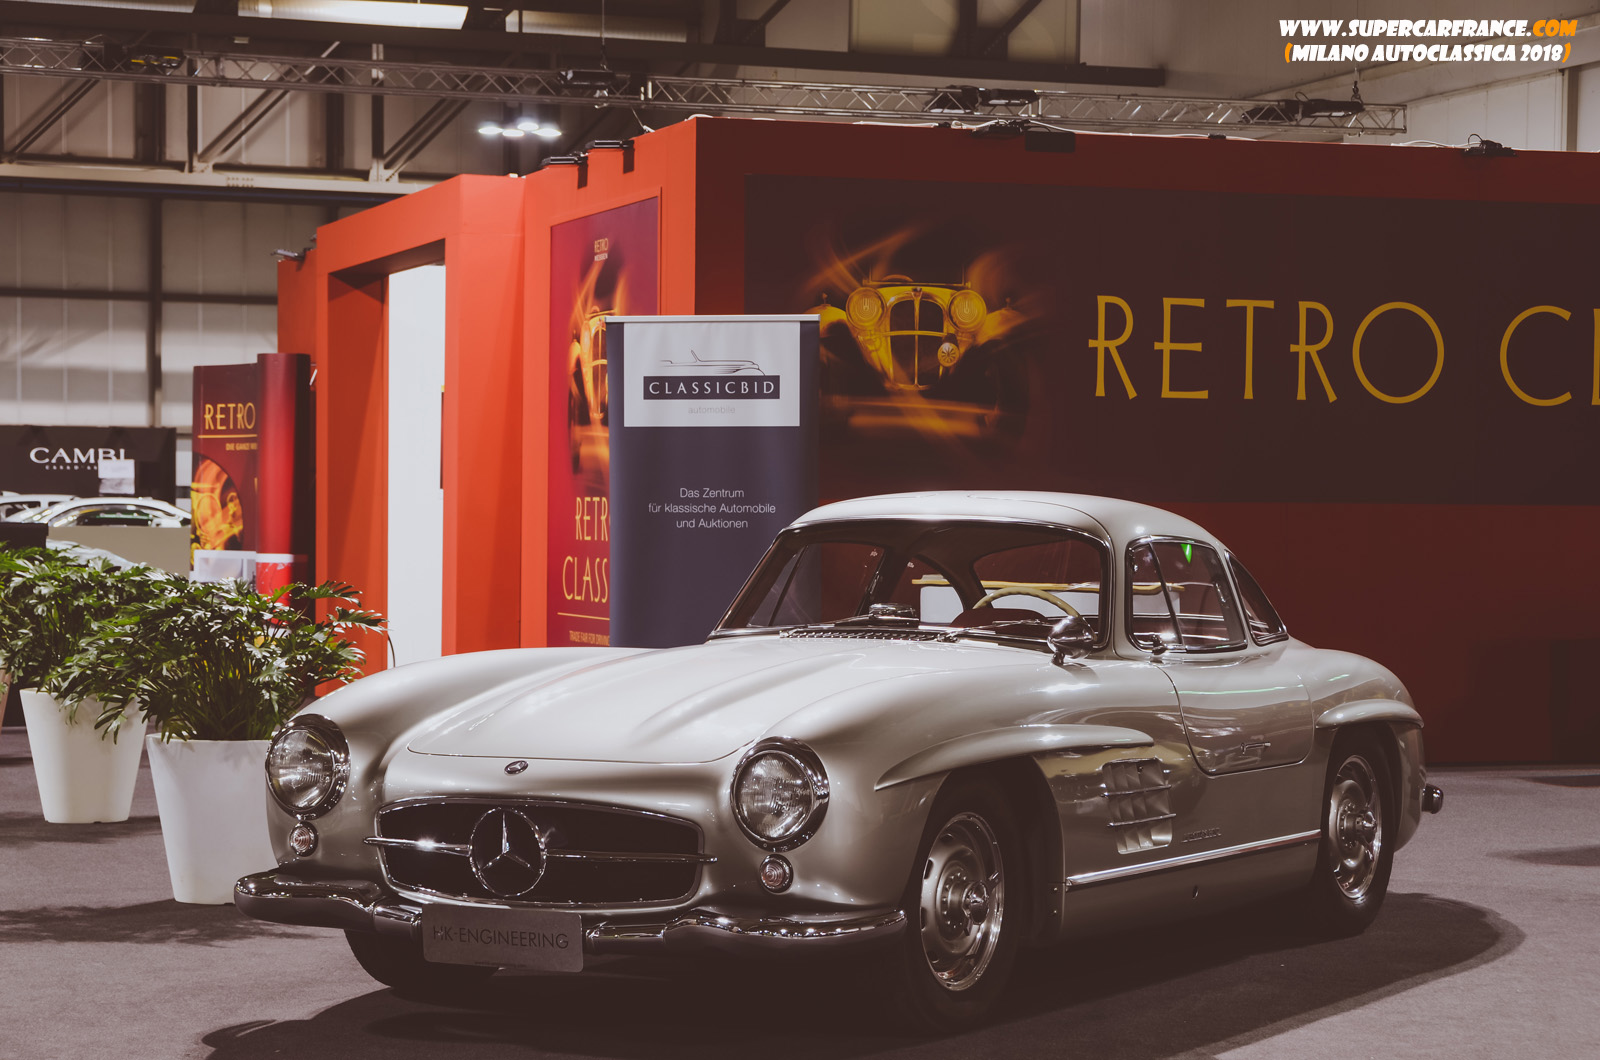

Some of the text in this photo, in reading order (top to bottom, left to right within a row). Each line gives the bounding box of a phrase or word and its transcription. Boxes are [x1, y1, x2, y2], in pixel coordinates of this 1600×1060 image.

[1088, 295, 1600, 407] RETRO C
[649, 381, 774, 395] CLASSICBID
[203, 402, 256, 430] RETRO
[688, 406, 736, 415] automobile
[680, 487, 745, 498] Das Zentrum
[649, 503, 776, 513] für klassische Automobile
[575, 497, 610, 541] RETR
[676, 518, 749, 528] und Auktionen
[433, 925, 569, 949] HK-ENGINEERING
